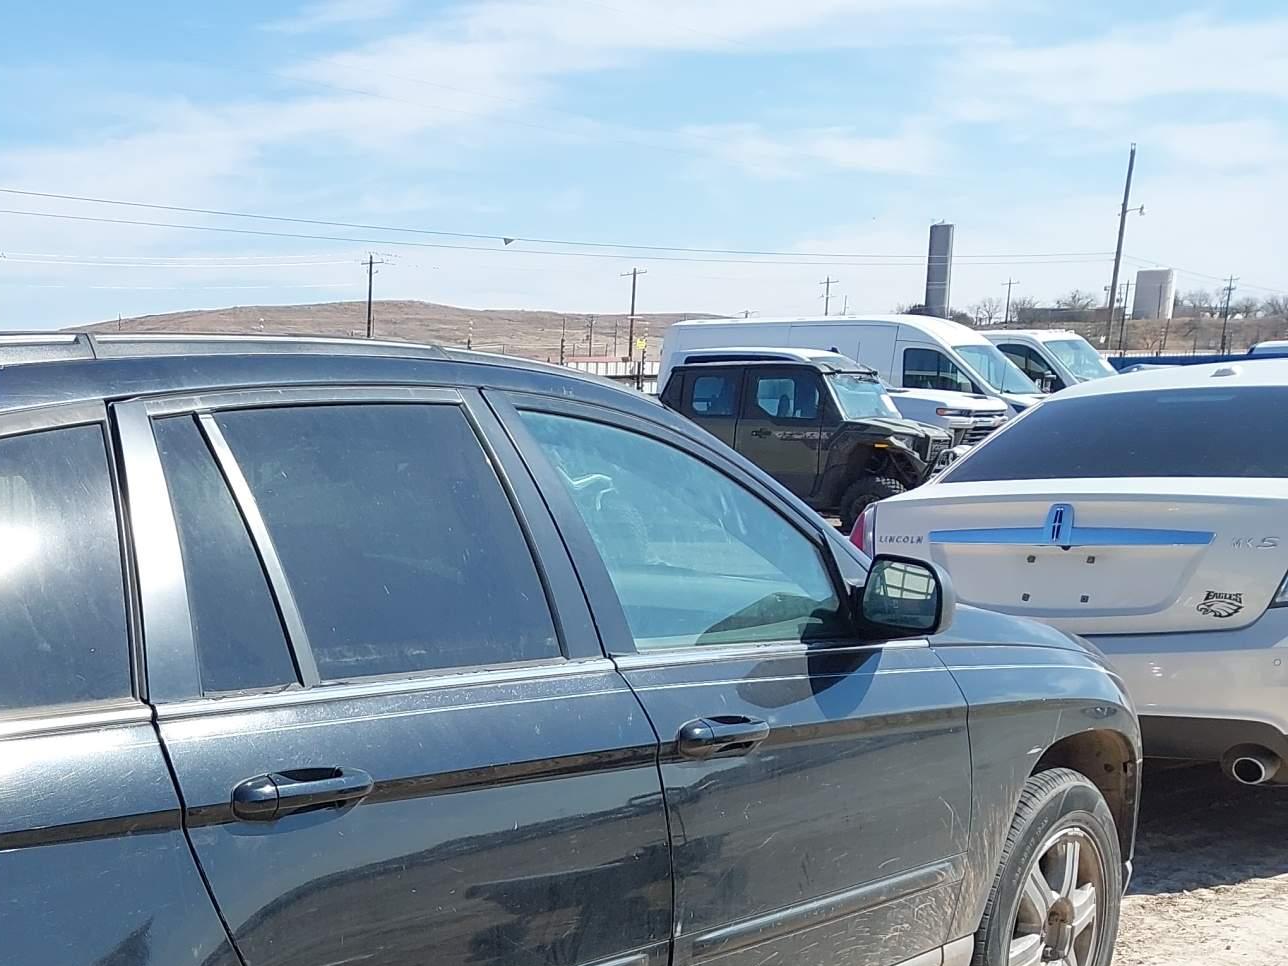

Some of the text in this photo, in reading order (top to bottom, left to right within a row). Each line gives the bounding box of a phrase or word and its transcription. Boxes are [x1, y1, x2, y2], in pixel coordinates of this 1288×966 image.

[879, 535, 923, 545] LINCOLN
[1231, 535, 1281, 550] MKS
[1203, 590, 1245, 604] EAGLES
